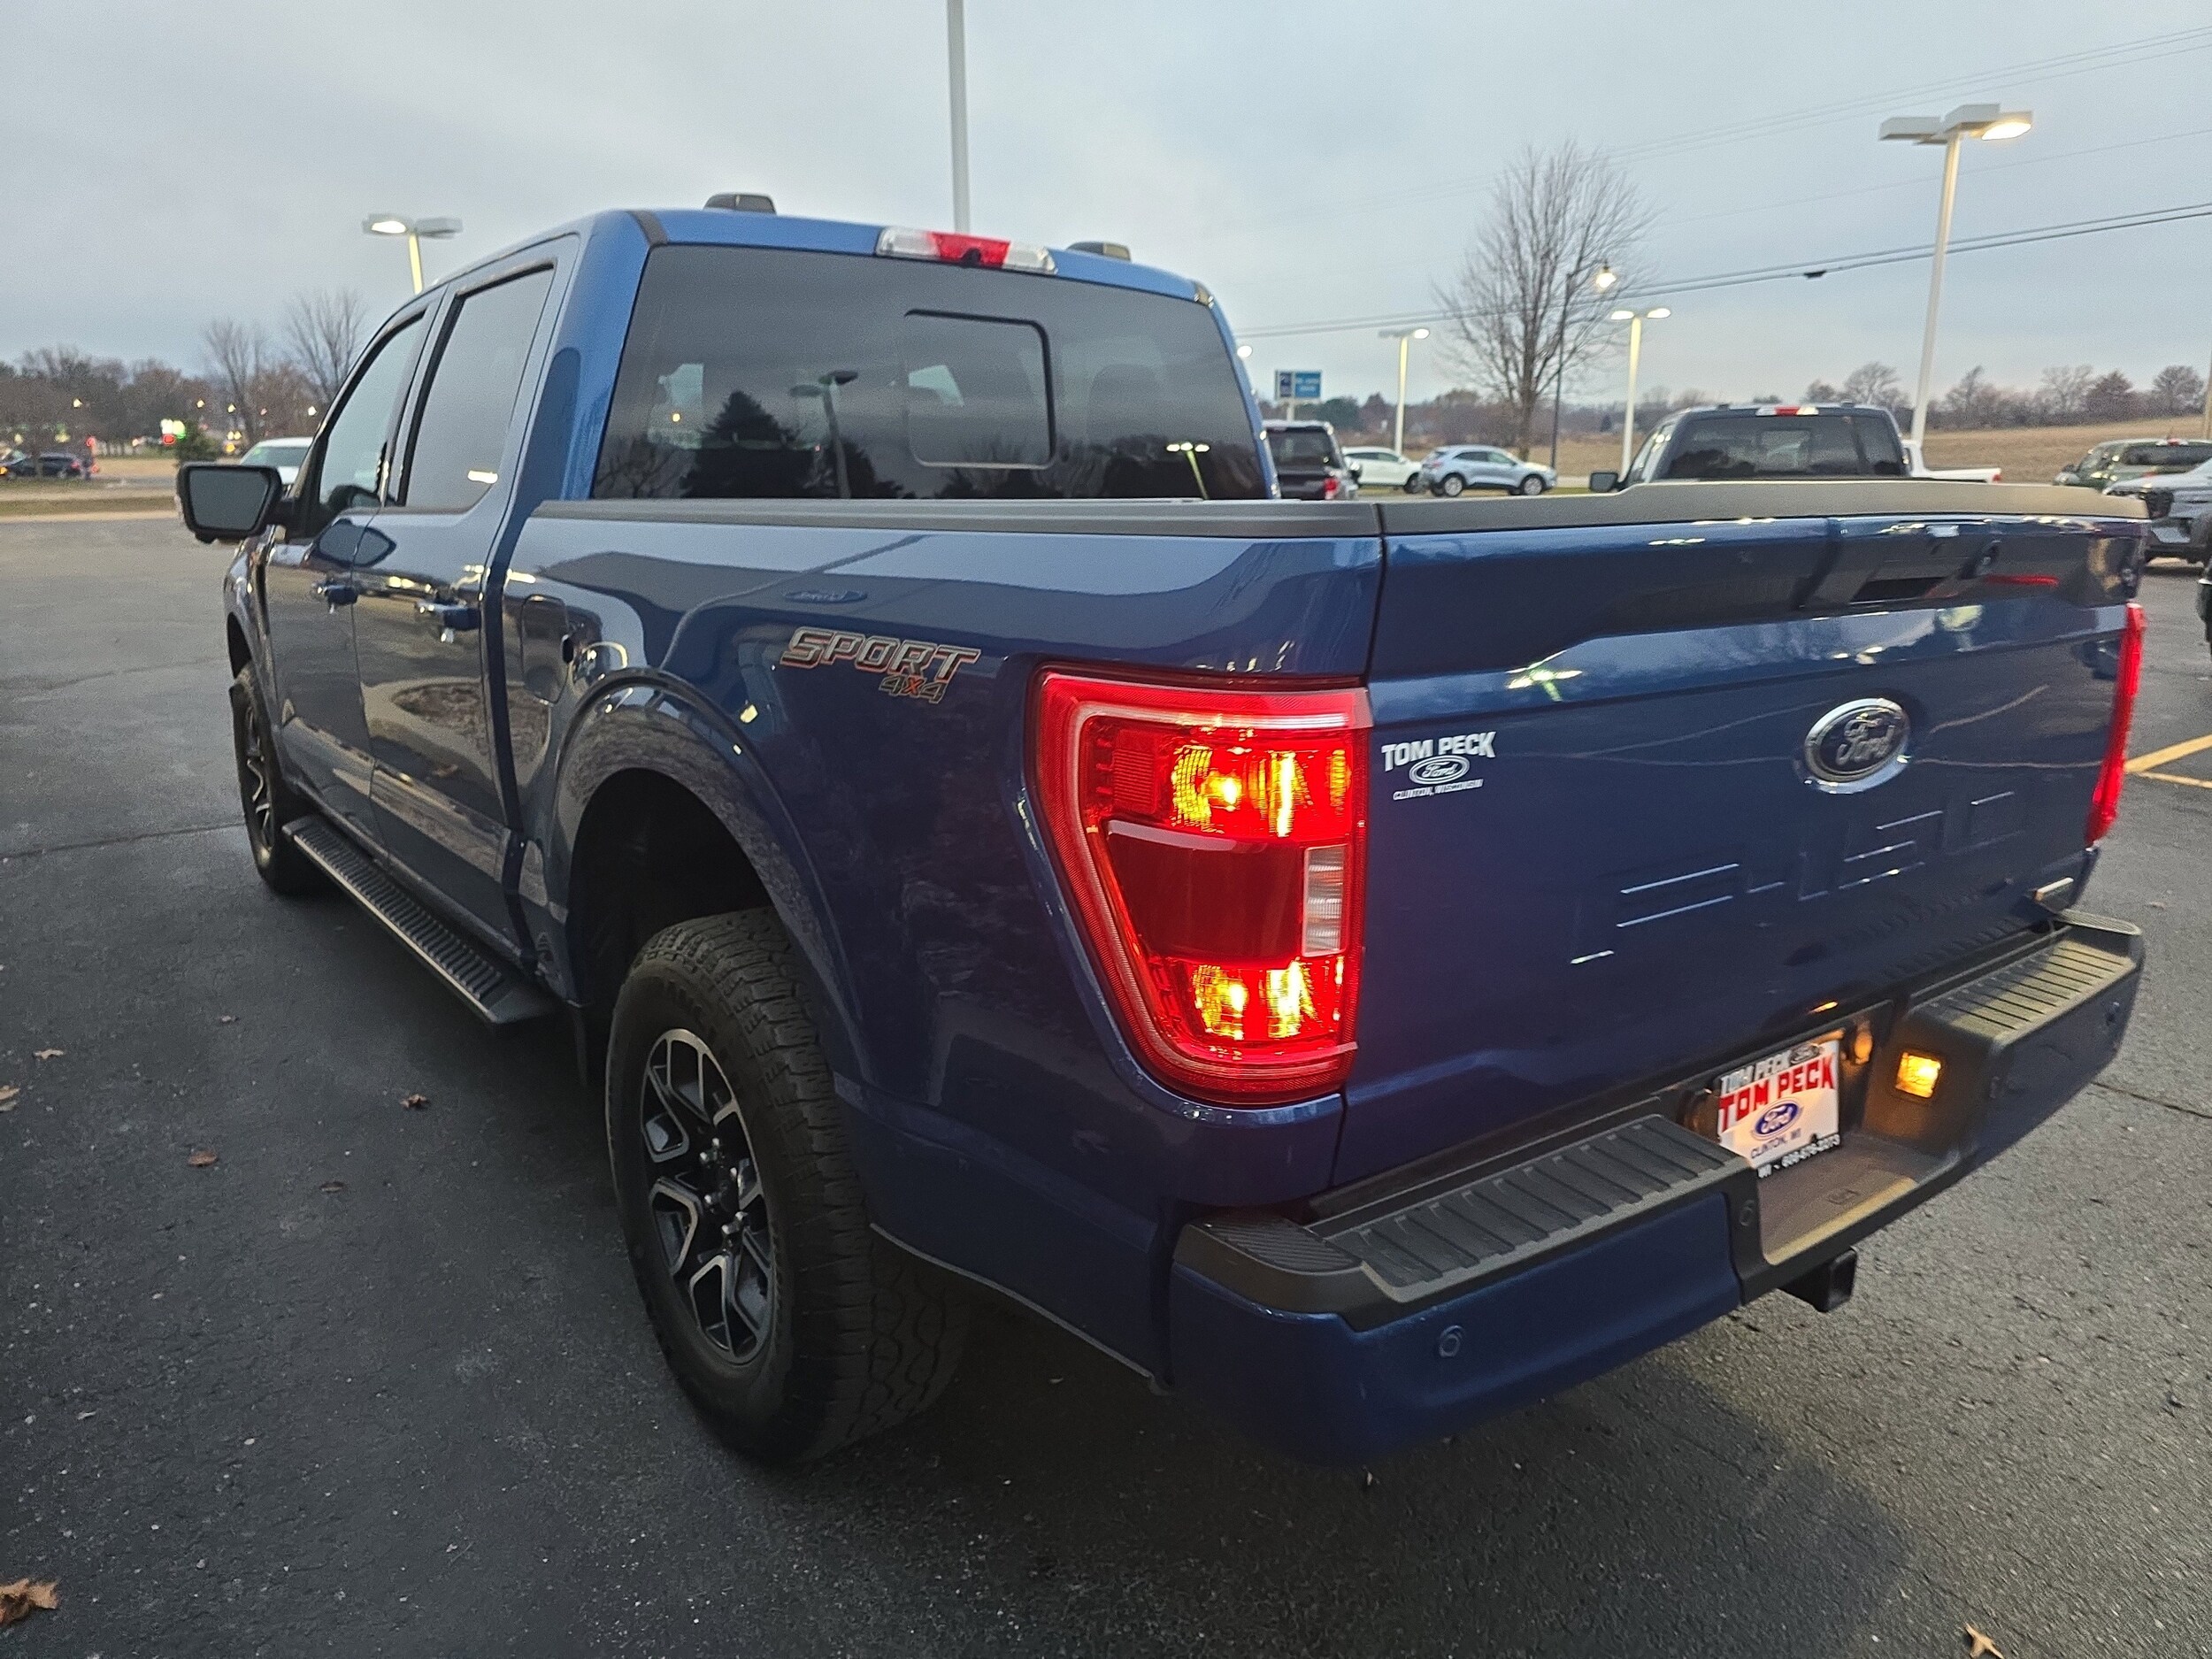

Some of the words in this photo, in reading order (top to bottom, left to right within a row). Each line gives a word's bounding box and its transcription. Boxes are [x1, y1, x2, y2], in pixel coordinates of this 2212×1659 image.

[780, 626, 982, 684] SPORT
[1380, 739, 1433, 772] TOM
[1438, 731, 1497, 758] PECK
[1835, 718, 1895, 766] Ford
[1421, 761, 1460, 779] Ford
[1720, 1064, 1755, 1094] TOM
[1754, 1049, 1793, 1081] PECK
[1718, 1079, 1770, 1134] TOM
[1777, 1055, 1835, 1099] PECK
[1760, 1104, 1795, 1135] Ford
